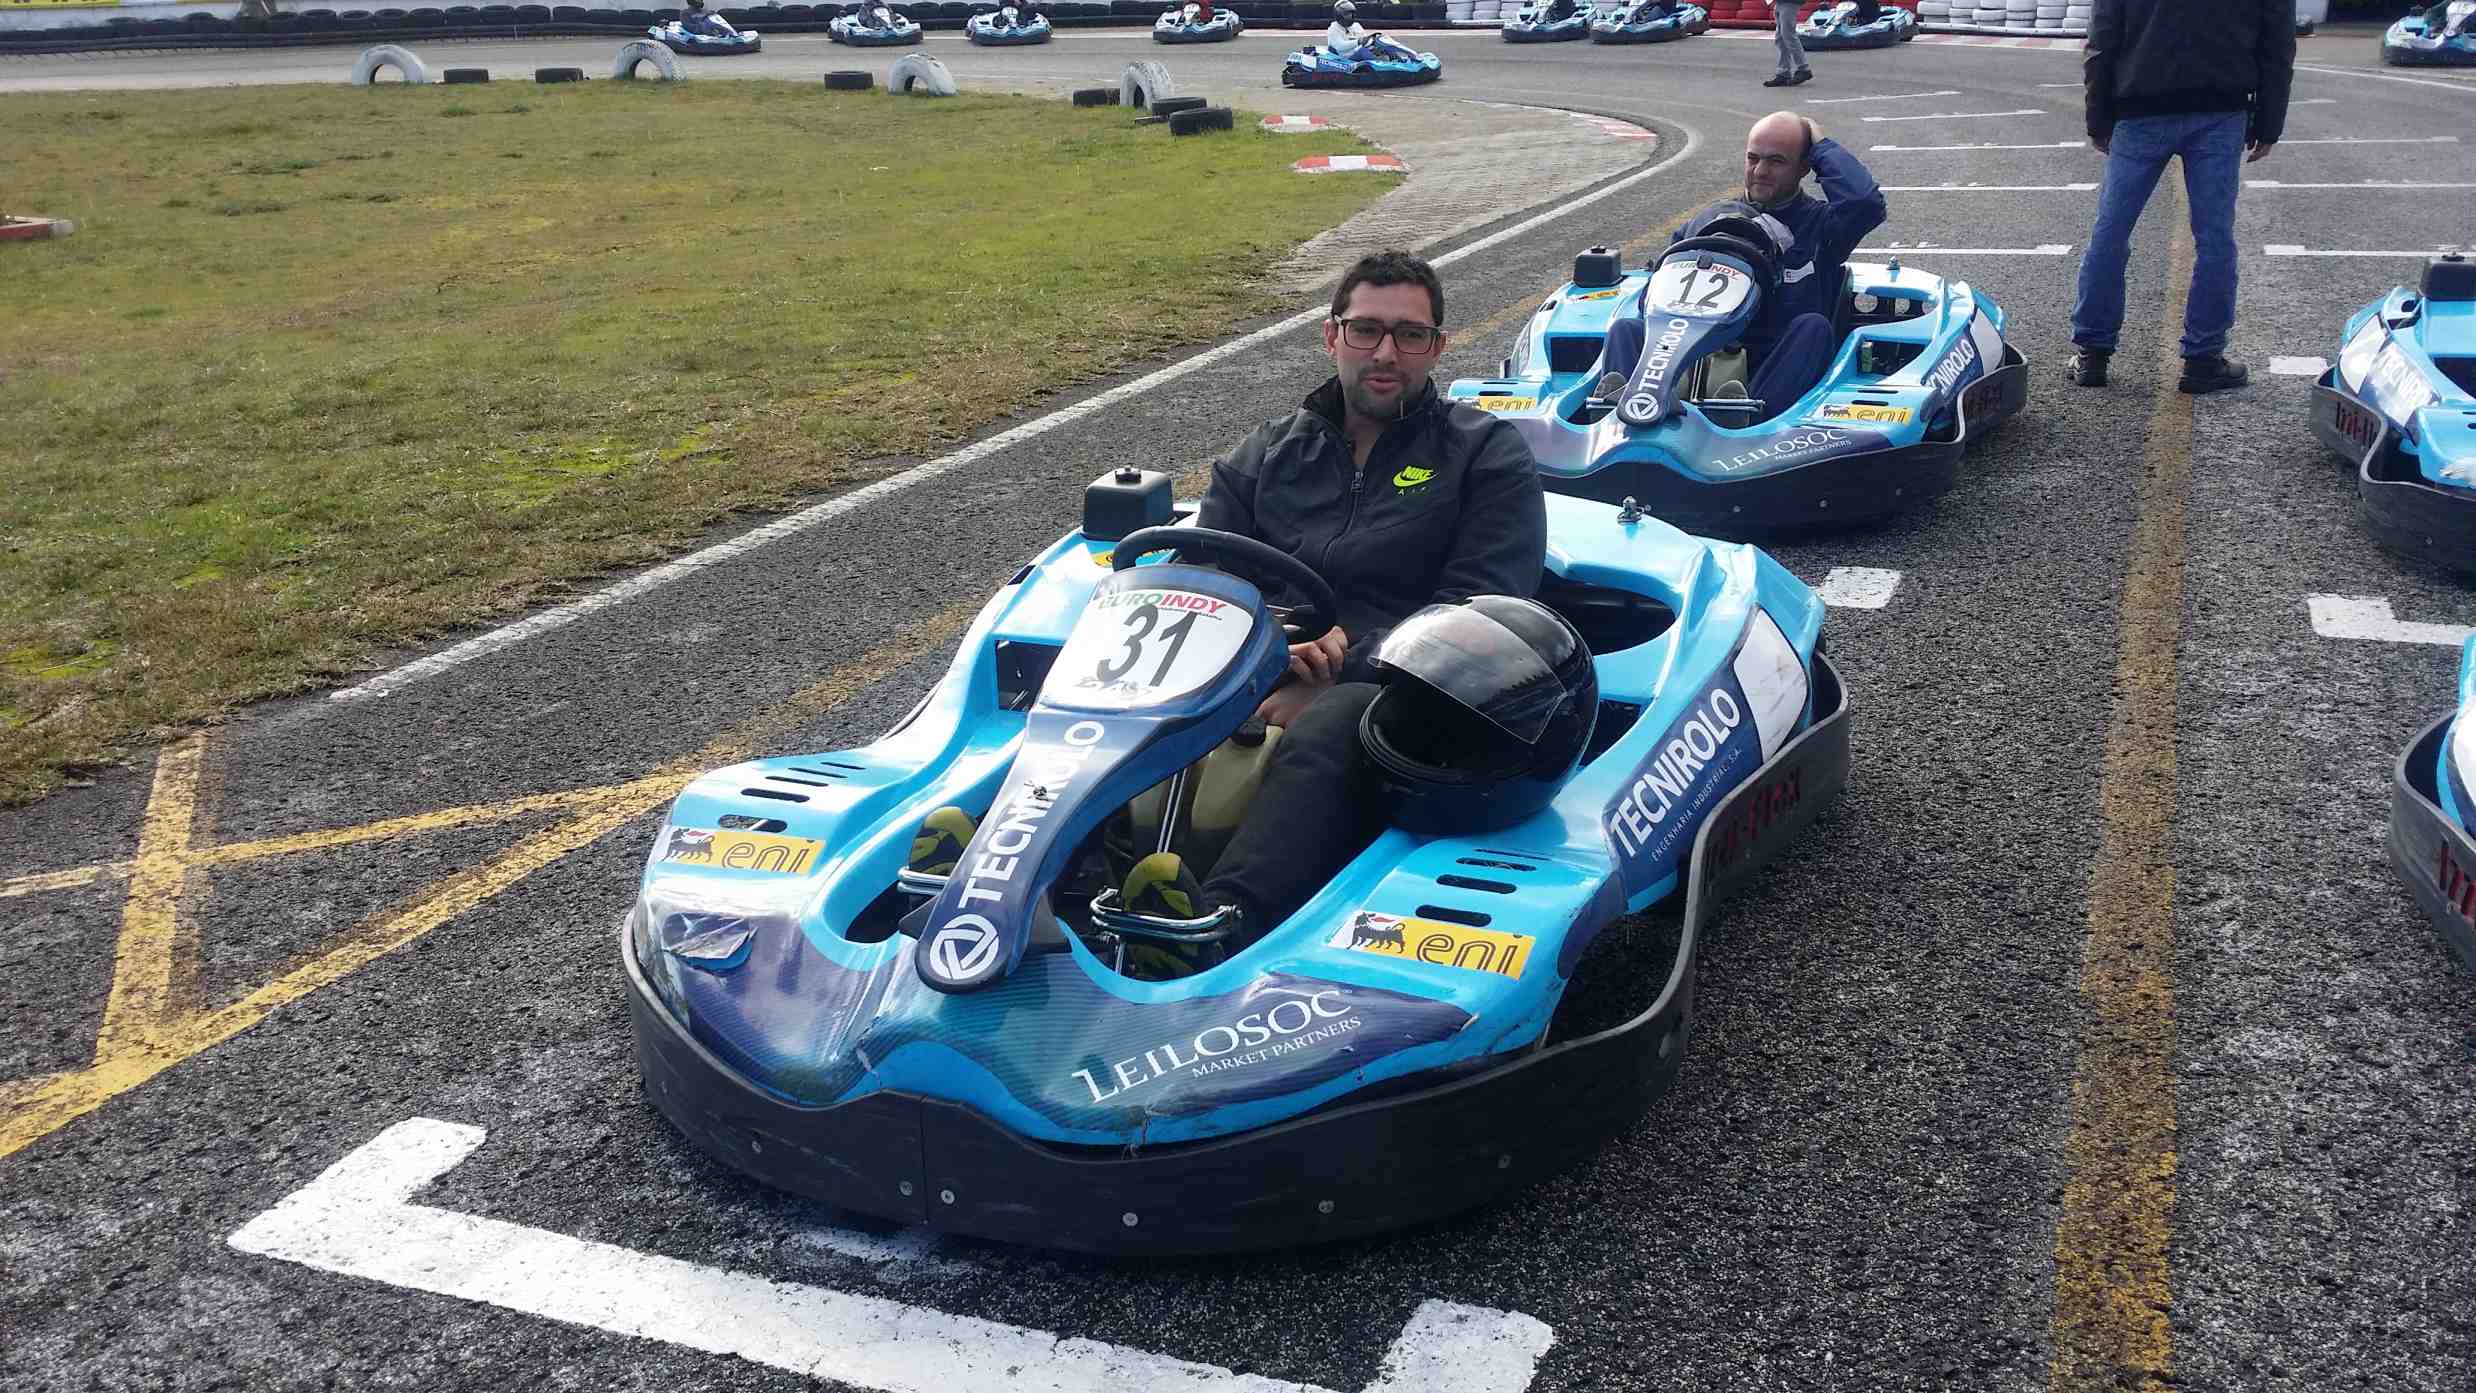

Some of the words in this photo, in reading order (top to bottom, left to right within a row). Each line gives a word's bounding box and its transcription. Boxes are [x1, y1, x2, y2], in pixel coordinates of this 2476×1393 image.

[1680, 269, 1729, 308] 12
[1856, 407, 1907, 422] eni
[1711, 428, 1848, 471] LEILOSOC
[1402, 465, 1435, 480] NIKE
[1096, 604, 1198, 687] 31
[1609, 688, 1740, 857] TECNIROLO
[721, 839, 816, 873] eni
[1416, 933, 1524, 974] eni
[1071, 989, 1352, 1103] LEILOSOC
[1192, 1048, 1268, 1078] MARKET
[1271, 1015, 1361, 1057] PARTNERS
